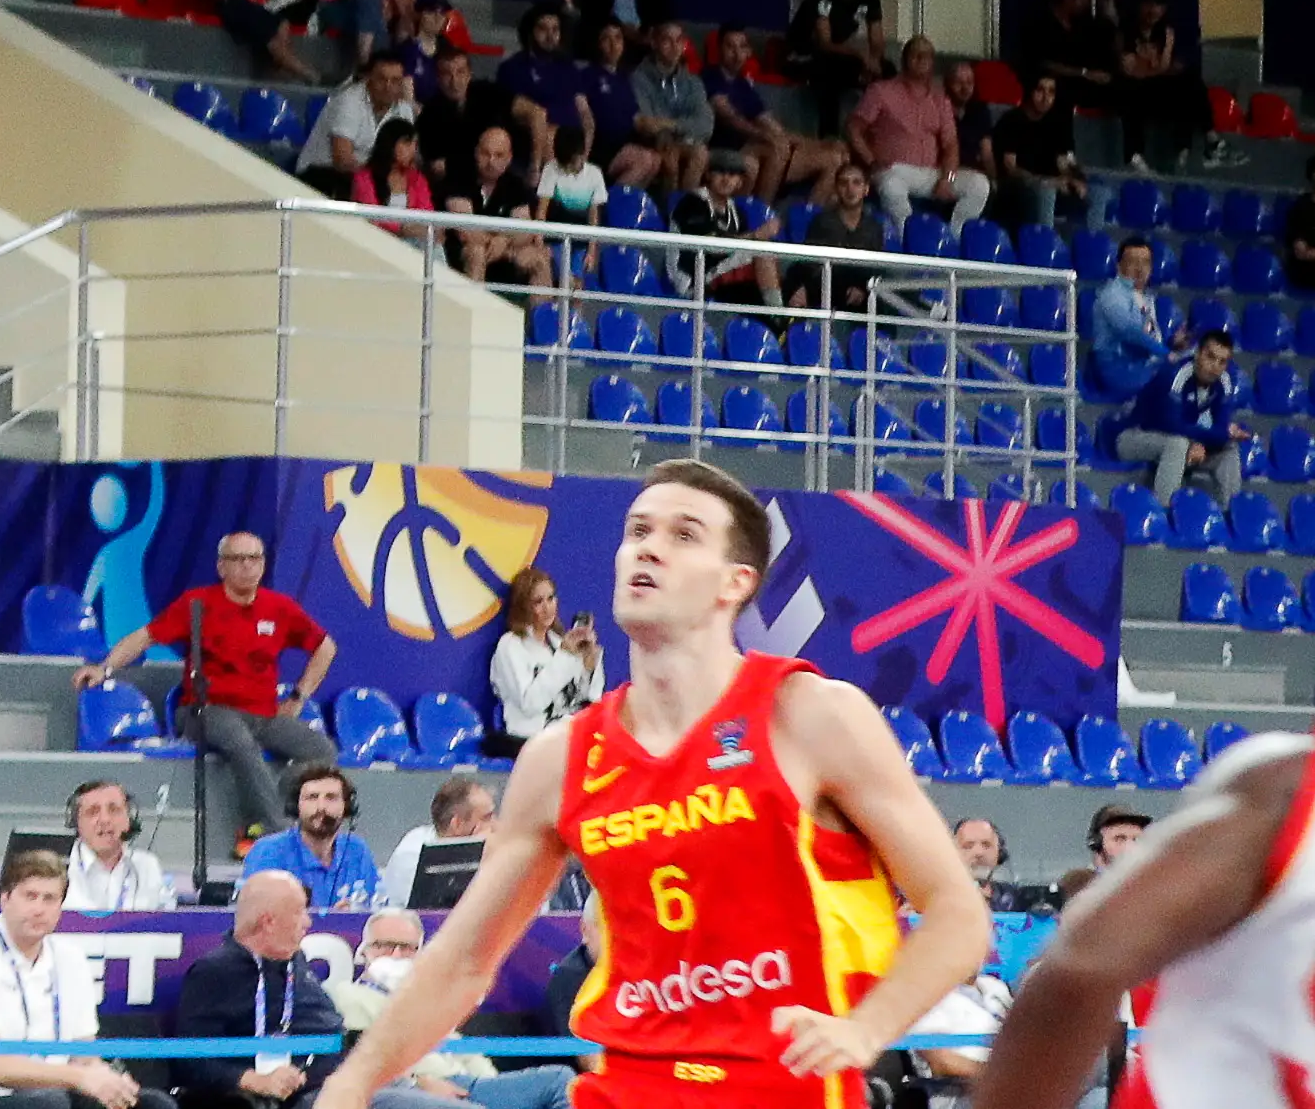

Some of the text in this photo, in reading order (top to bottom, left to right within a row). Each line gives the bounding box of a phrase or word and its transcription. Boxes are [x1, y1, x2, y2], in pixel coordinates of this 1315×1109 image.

[579, 784, 757, 856] ESPAÑA
[649, 864, 695, 932] 6
[615, 949, 792, 1019] endesa
[674, 1061, 727, 1083] ESP
